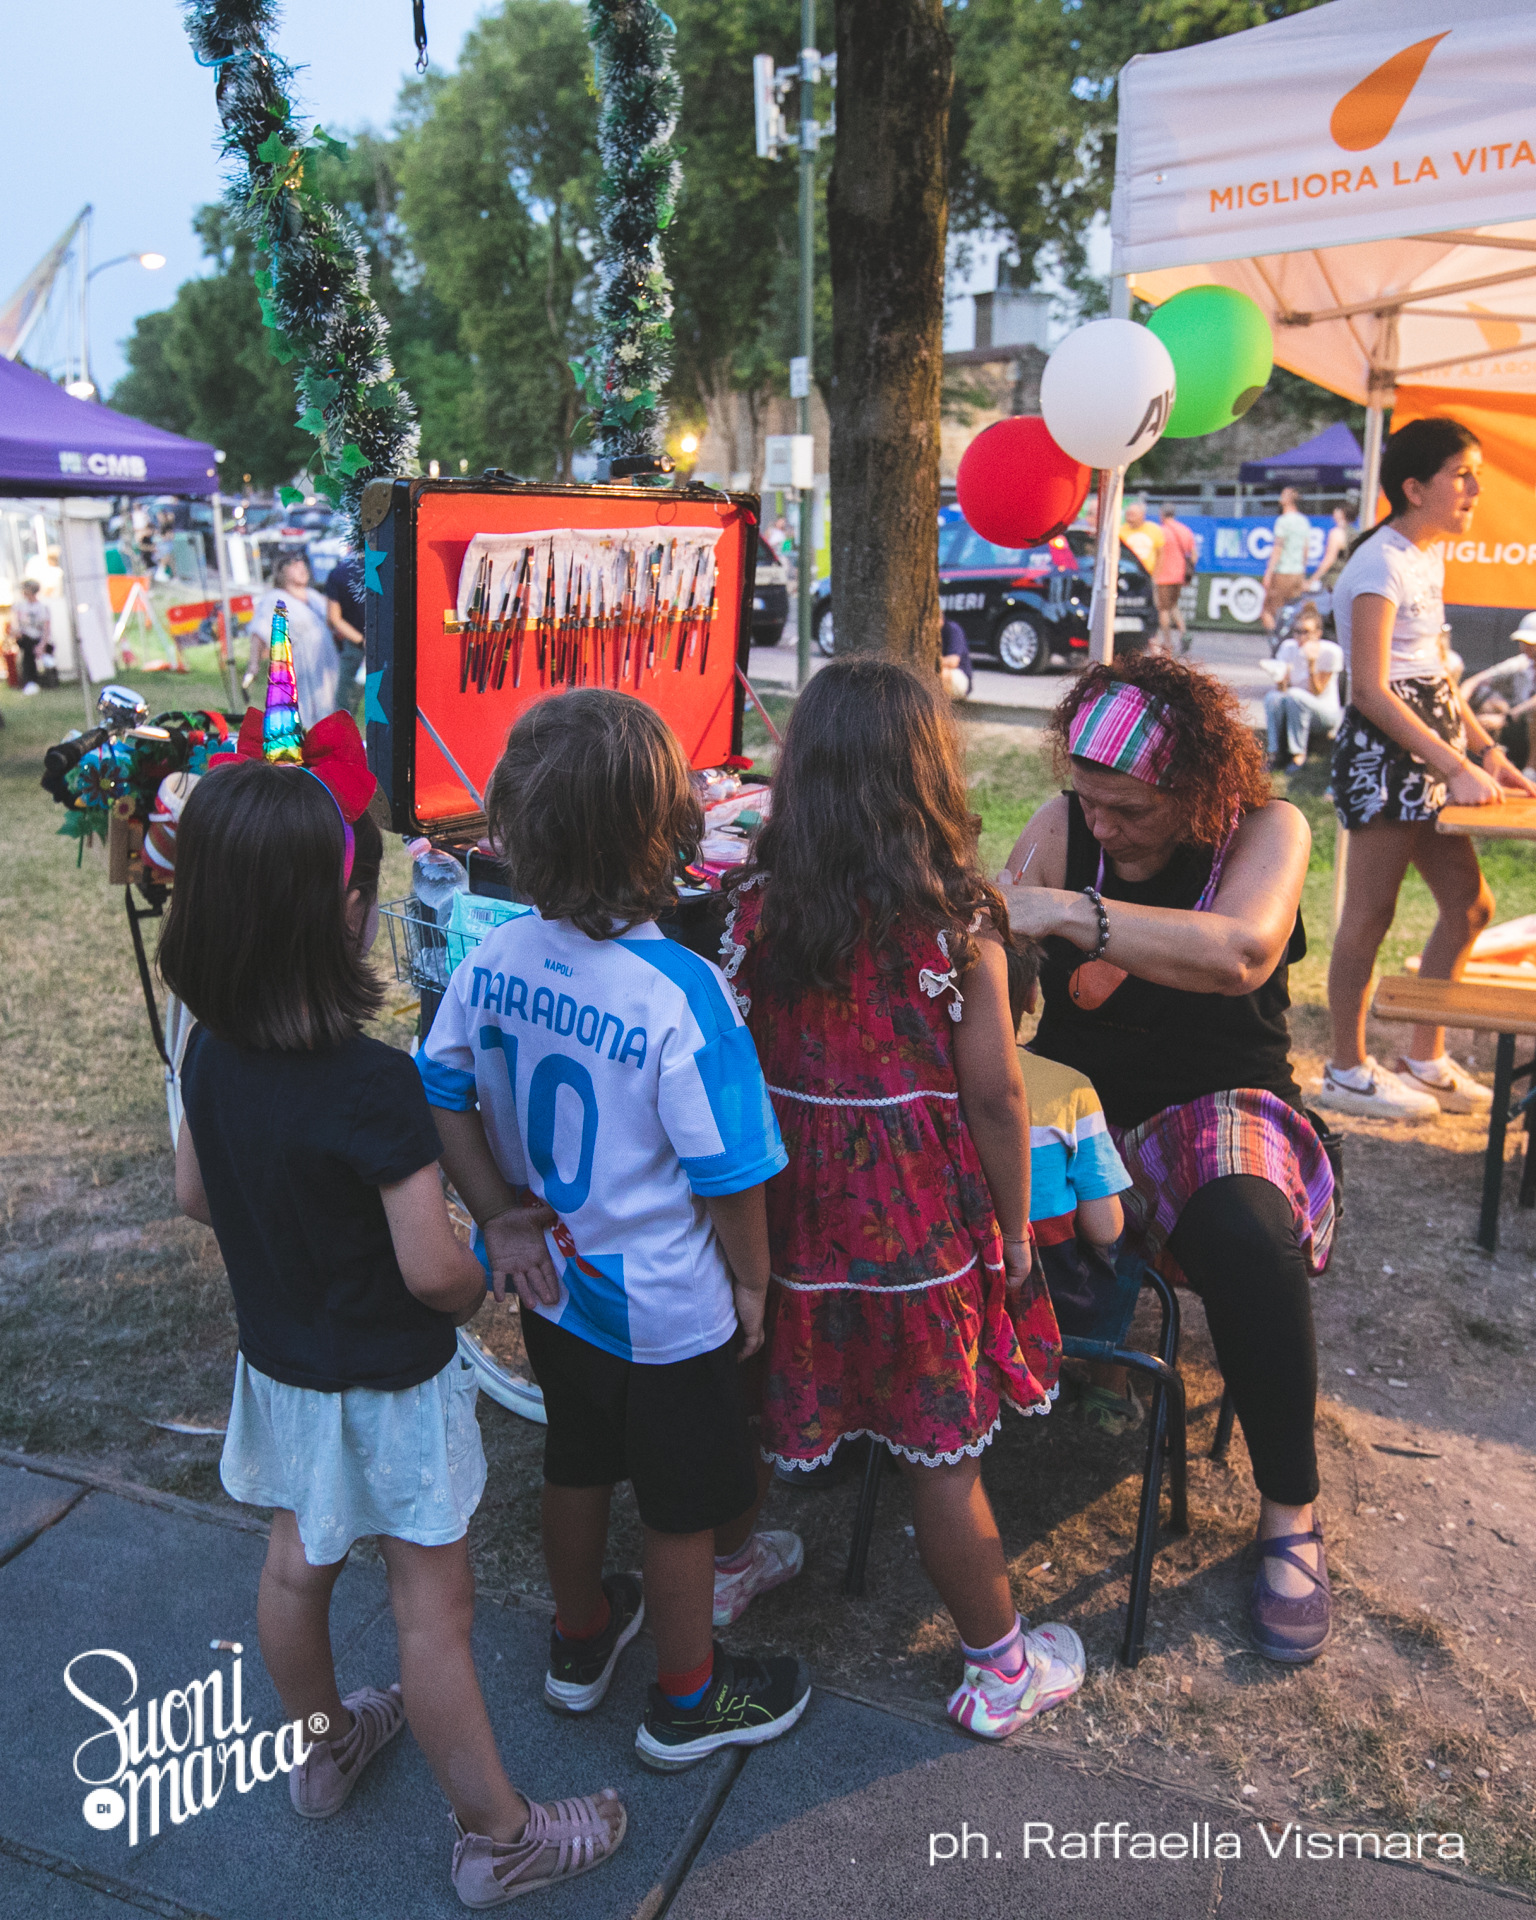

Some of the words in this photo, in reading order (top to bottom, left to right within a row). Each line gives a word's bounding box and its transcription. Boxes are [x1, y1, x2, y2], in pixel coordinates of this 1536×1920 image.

[1209, 165, 1379, 213] MIGLIORA
[1393, 156, 1439, 185] LA
[1453, 139, 1536, 177] VITA
[1247, 527, 1325, 560] CB
[544, 958, 573, 978] NAPOLI
[479, 1025, 599, 1214] 10
